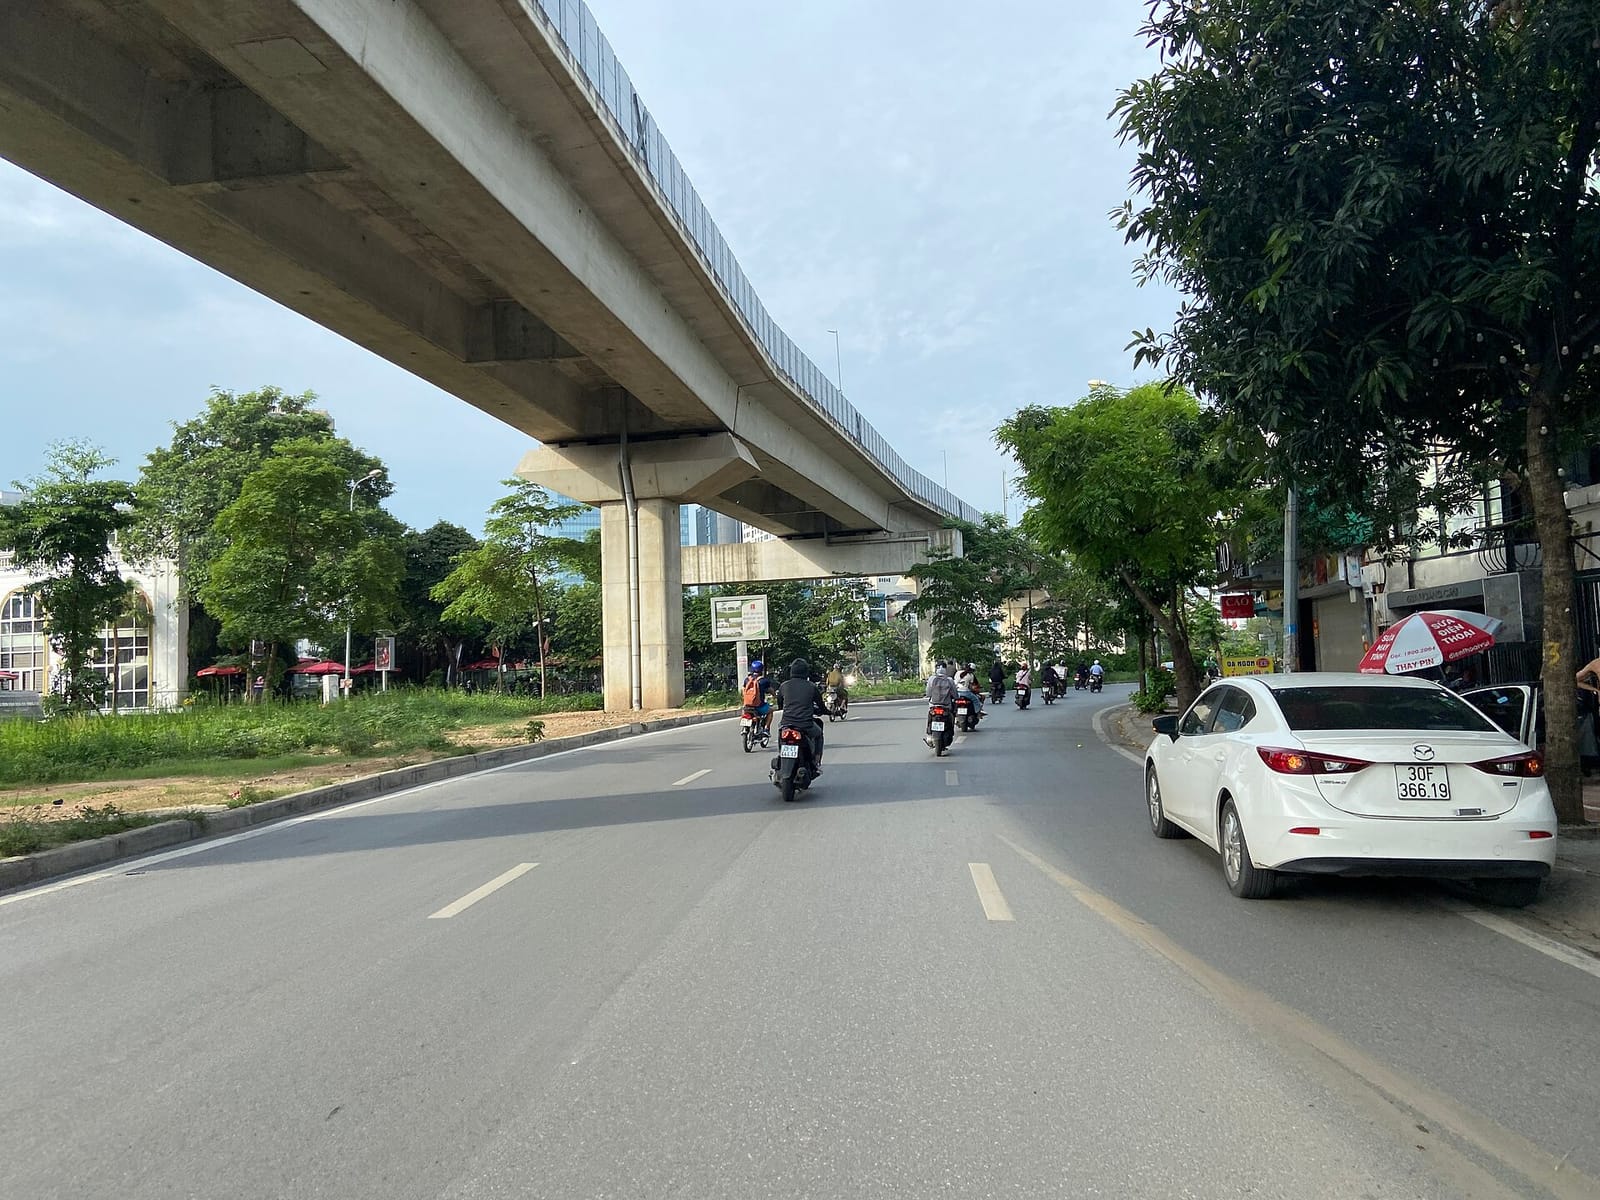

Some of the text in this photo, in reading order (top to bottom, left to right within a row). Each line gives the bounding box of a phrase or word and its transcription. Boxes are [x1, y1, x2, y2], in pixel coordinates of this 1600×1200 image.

[1431, 618, 1456, 630] SỬA
[1438, 623, 1465, 636] ĐIỆN
[1441, 629, 1476, 644] THOẠI
[1395, 661, 1417, 671] THAY
[1419, 658, 1435, 667] PIN
[1408, 766, 1434, 781] 30F
[1399, 783, 1448, 798] 366.19
